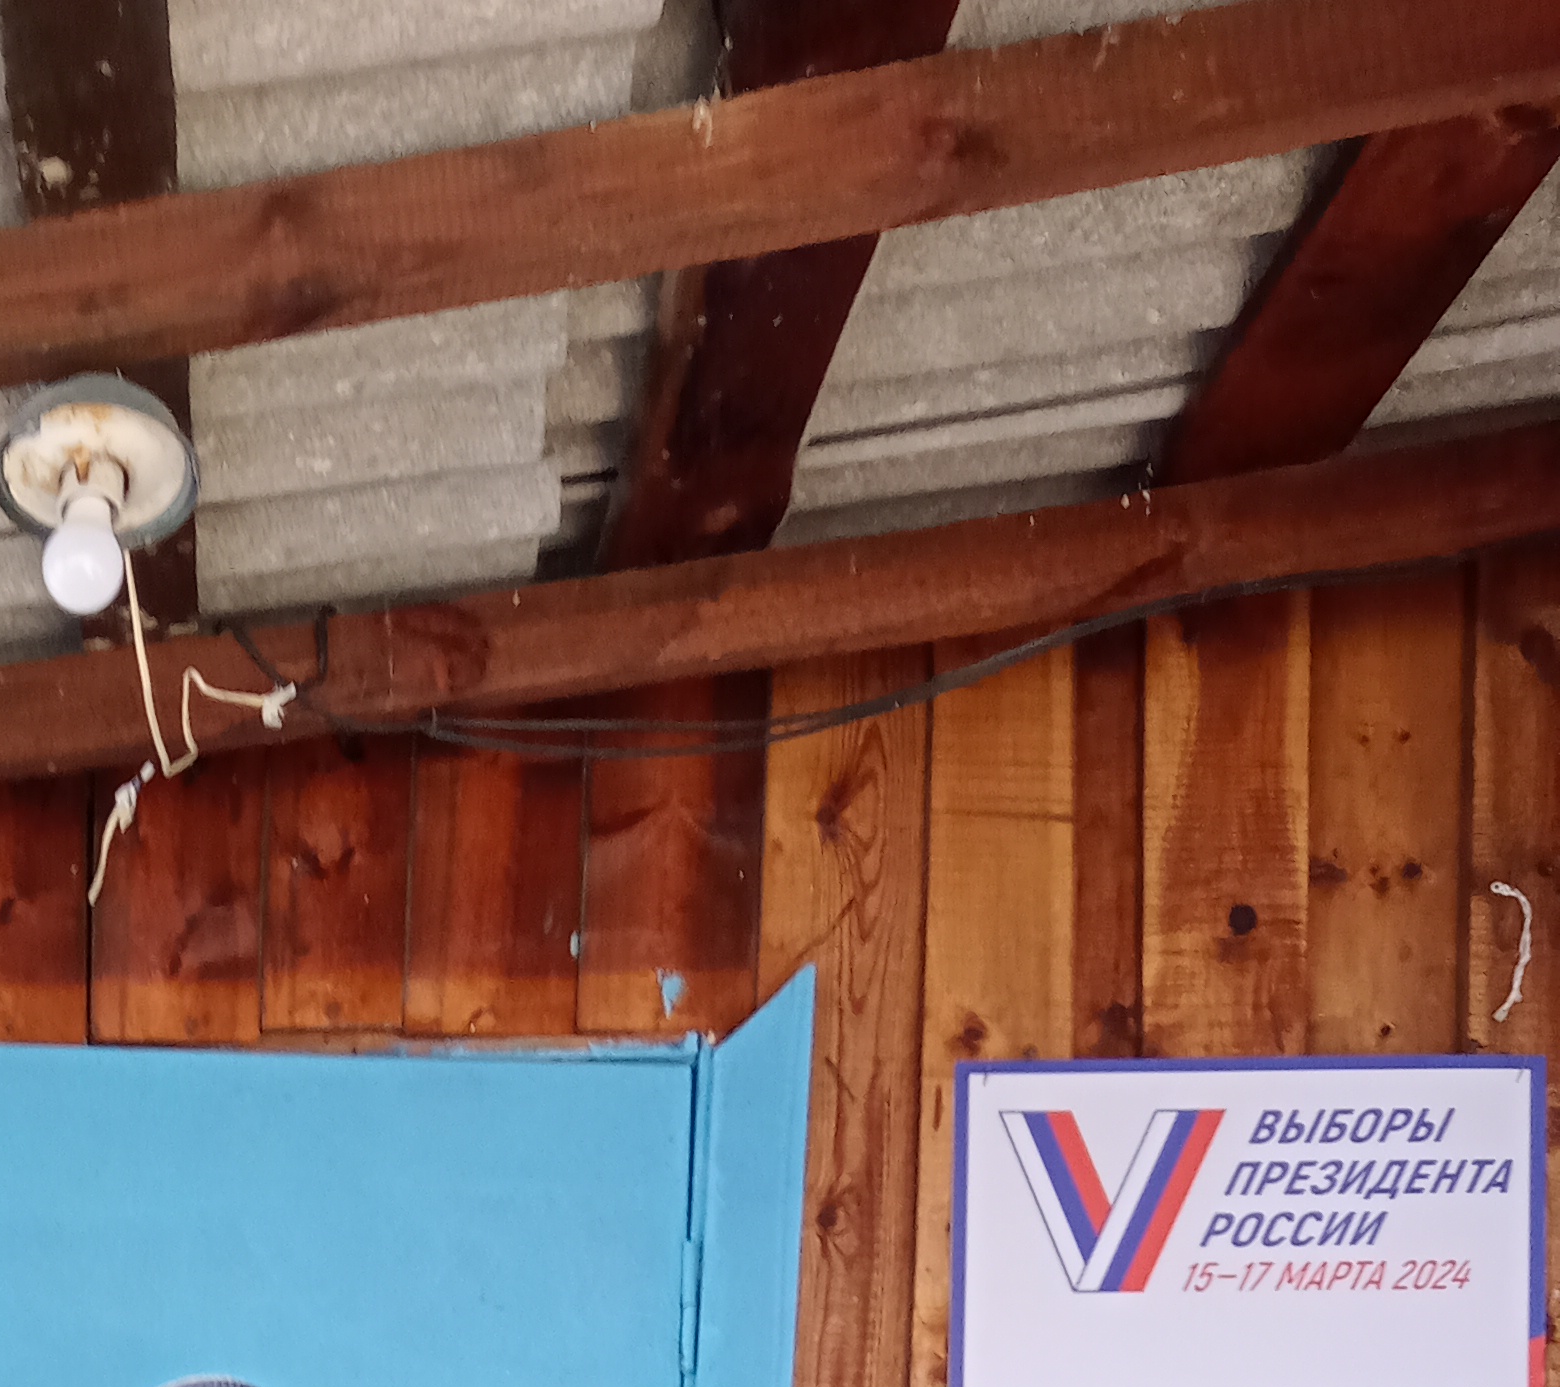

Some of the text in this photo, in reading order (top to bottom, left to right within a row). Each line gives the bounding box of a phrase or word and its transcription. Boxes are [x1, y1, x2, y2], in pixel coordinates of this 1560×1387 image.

[1248, 1107, 1456, 1145] ВЫБОРЫ
[1224, 1158, 1514, 1200] ПРЕЗИДЕНТА
[1199, 1210, 1389, 1248] РОССИИ
[1275, 1259, 1388, 1292] МАРТА
[1391, 1258, 1473, 1291] 2024
